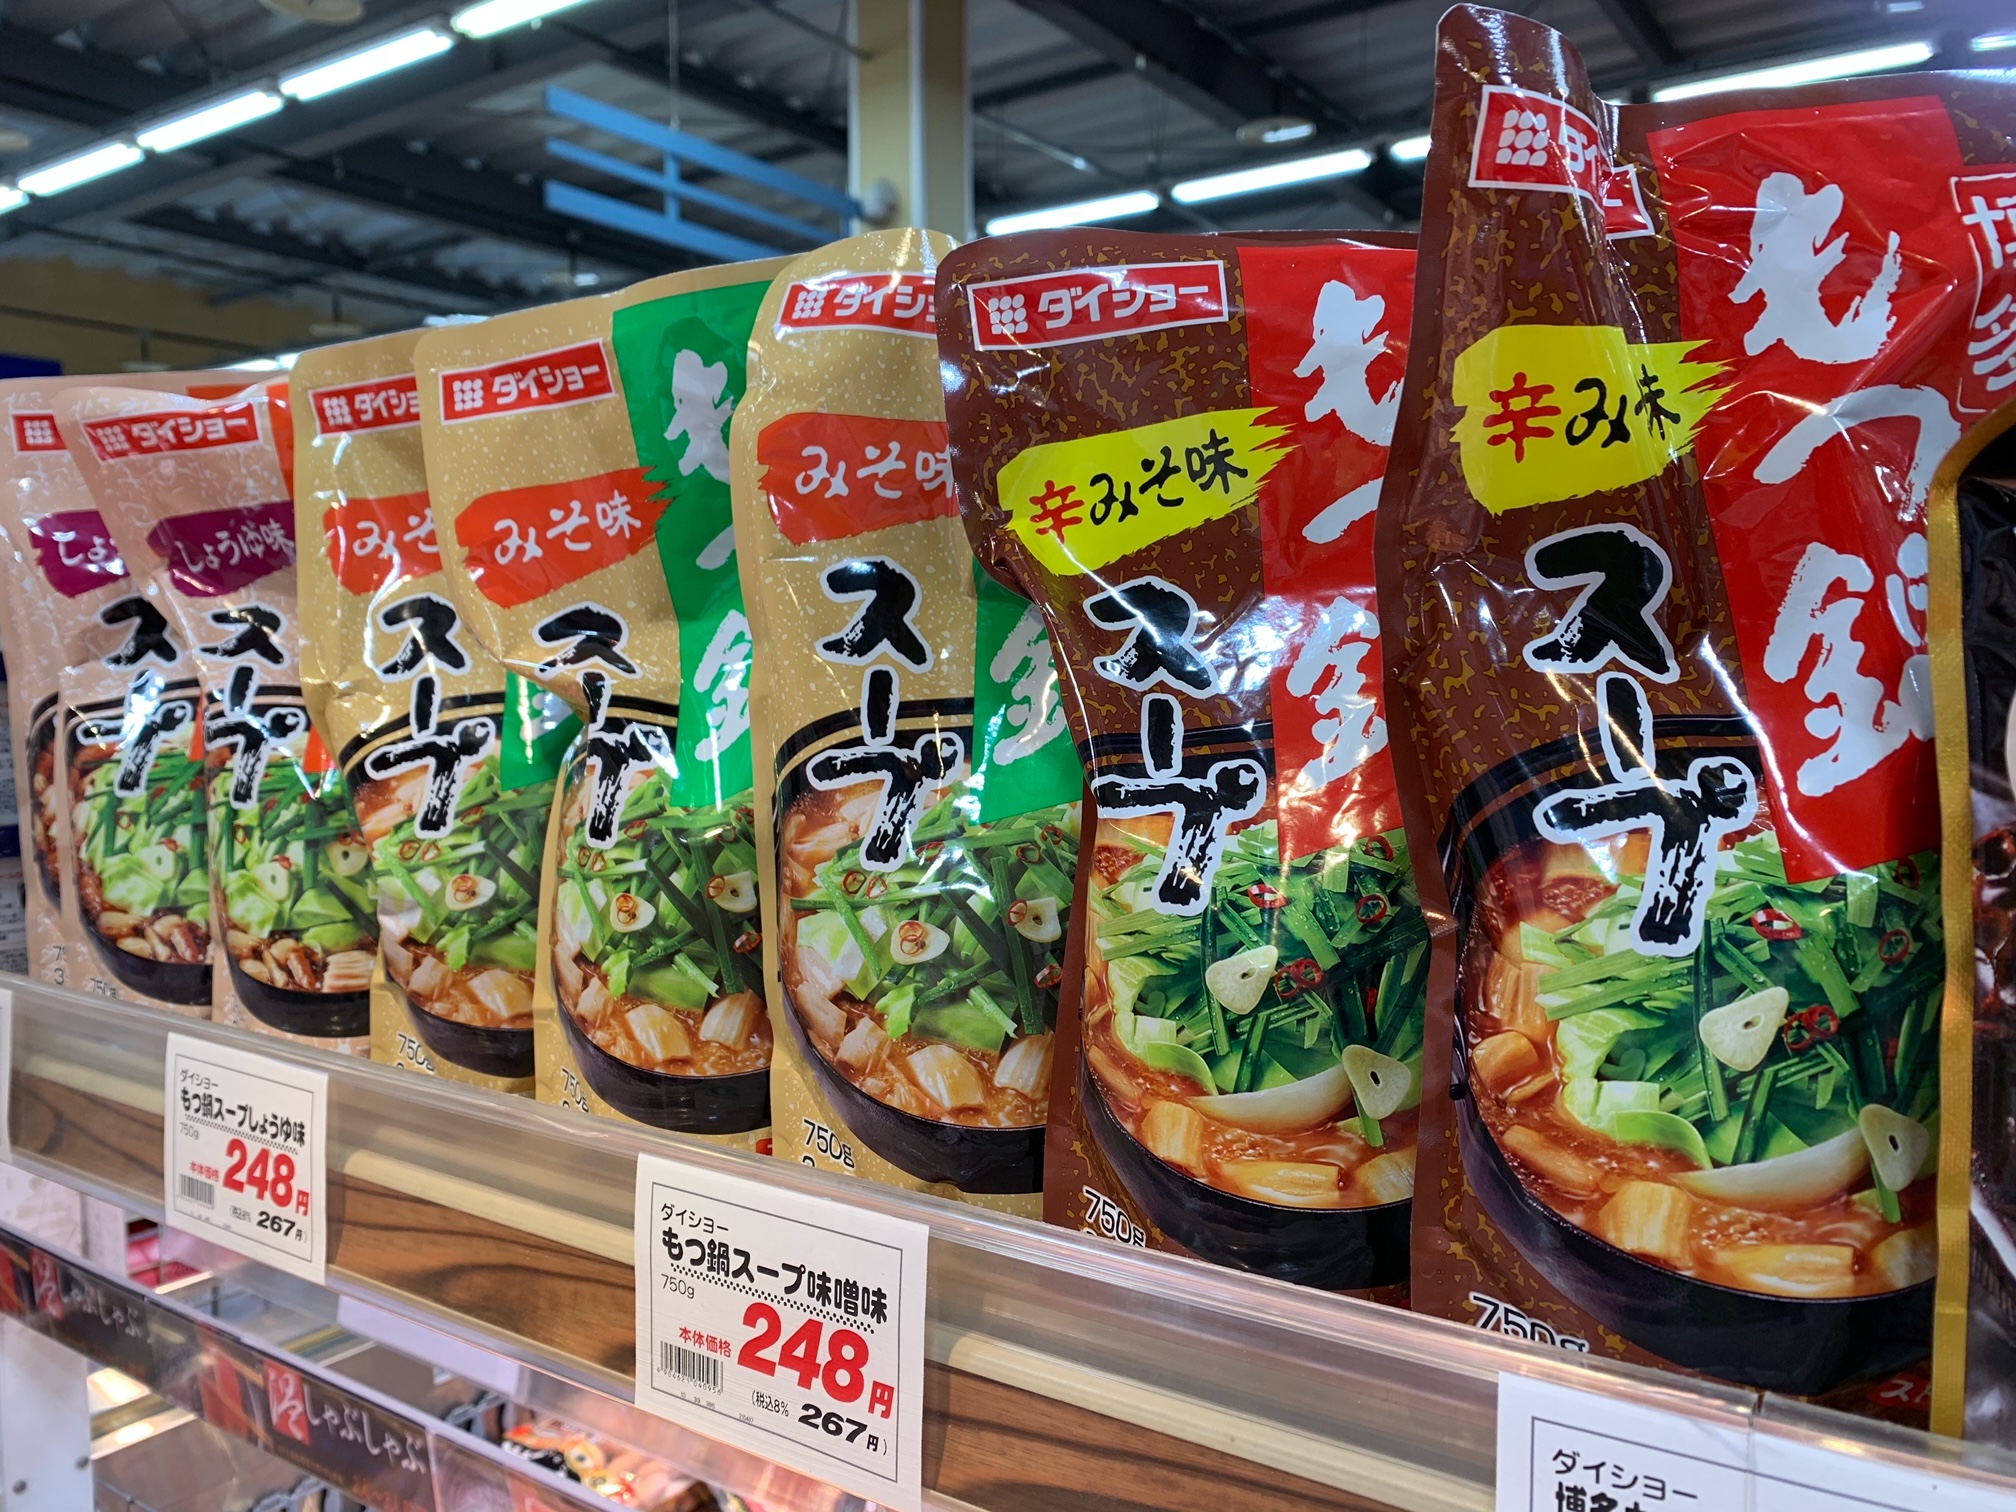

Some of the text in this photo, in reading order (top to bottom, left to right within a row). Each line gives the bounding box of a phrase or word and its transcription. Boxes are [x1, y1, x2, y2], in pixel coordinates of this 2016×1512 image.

[1037, 280, 1210, 327] ダイショー
[492, 364, 601, 402] ダイショー
[131, 413, 249, 449] ダイショー
[1028, 428, 1249, 544] 辛みそ味
[175, 517, 295, 573] しょうゆ味
[493, 489, 641, 564] みそ味
[200, 605, 307, 809] スープ
[366, 593, 496, 838] スープ
[533, 602, 677, 848] スープ
[805, 556, 964, 872] スープ
[1083, 576, 1267, 917] スープ
[1522, 521, 1757, 957] スープ
[180, 1068, 219, 1091] ダイショー
[180, 1087, 306, 1148] もつ鍋スープしょうゆ味
[802, 1117, 857, 1170] 750g
[661, 1203, 729, 1234] ダイショー
[661, 1226, 888, 1325] もつ鍋スープ味噌味
[661, 1273, 696, 1299] 750g
[678, 1326, 733, 1358] 本体価格
[751, 1389, 790, 1417] (税込8%
[1552, 1448, 1699, 1502] ダイショー
